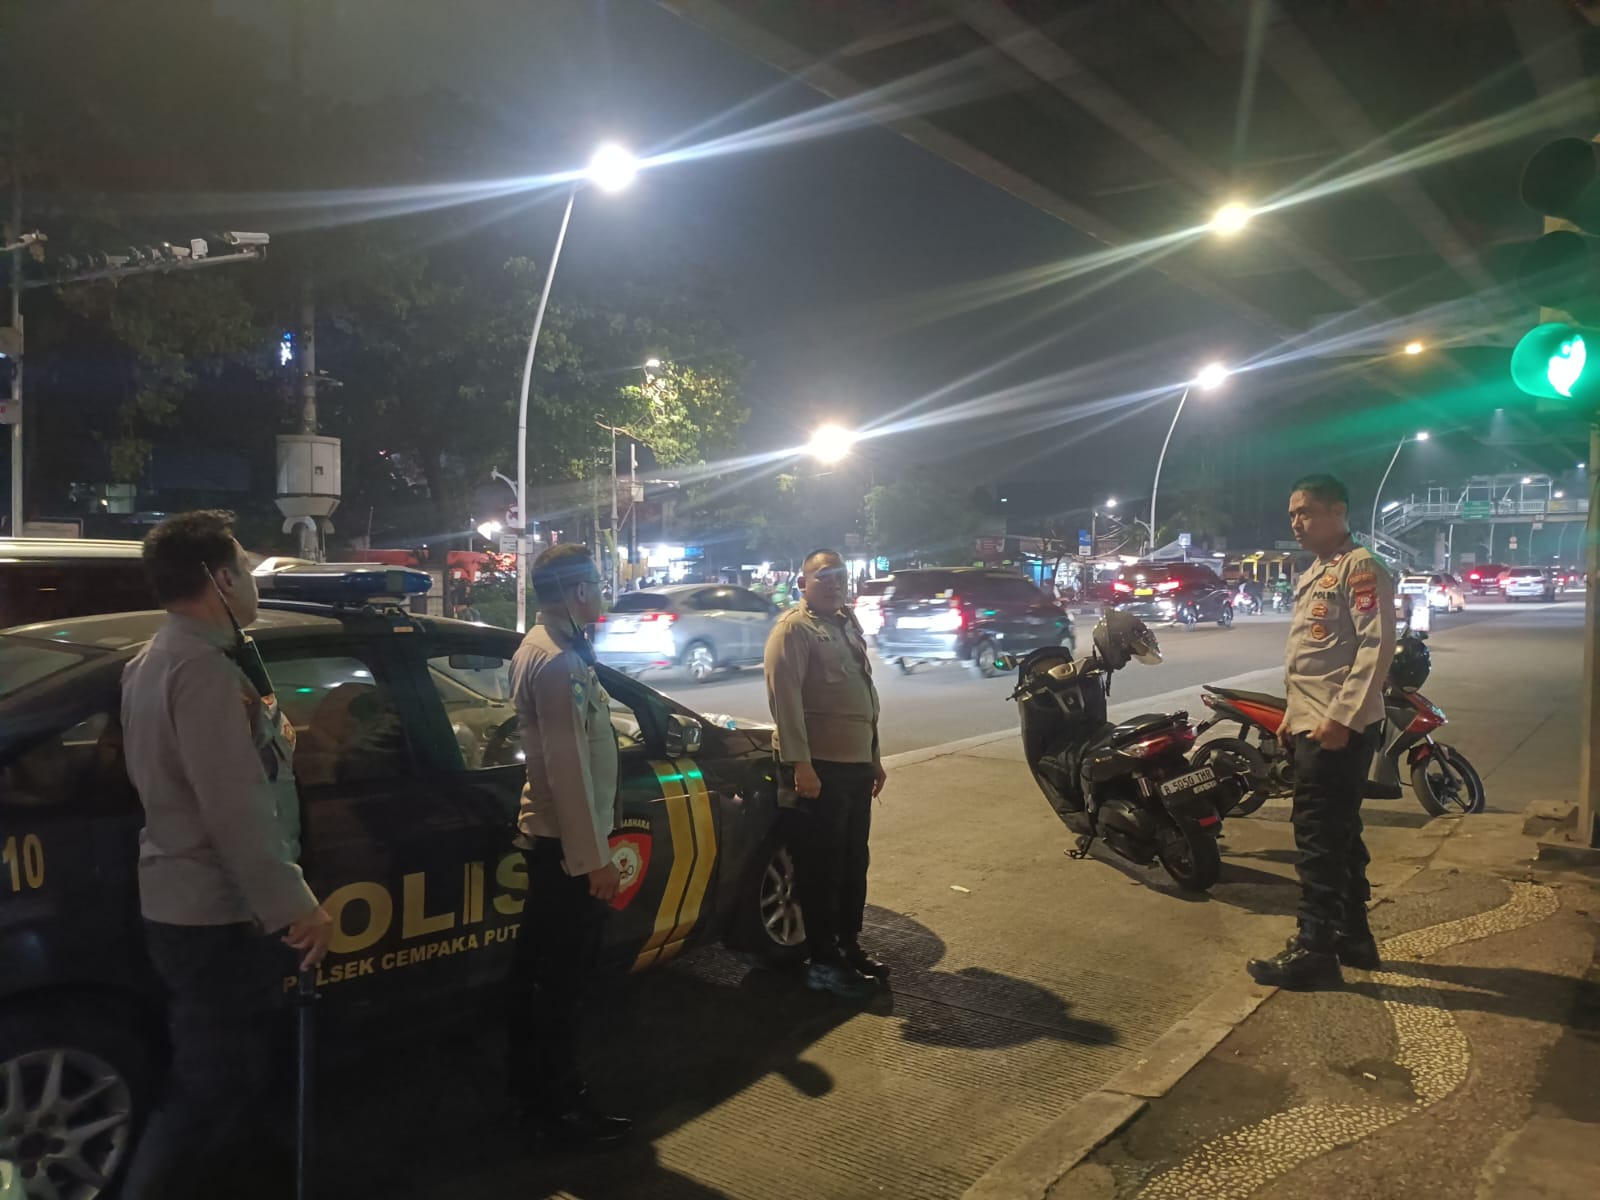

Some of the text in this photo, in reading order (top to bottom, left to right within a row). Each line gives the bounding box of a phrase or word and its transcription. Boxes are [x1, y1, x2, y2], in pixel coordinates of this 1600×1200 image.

[2, 833, 45, 891] 10
[325, 851, 529, 954] OLIS
[281, 923, 521, 992] PLSEK CEMPAKA PUT
